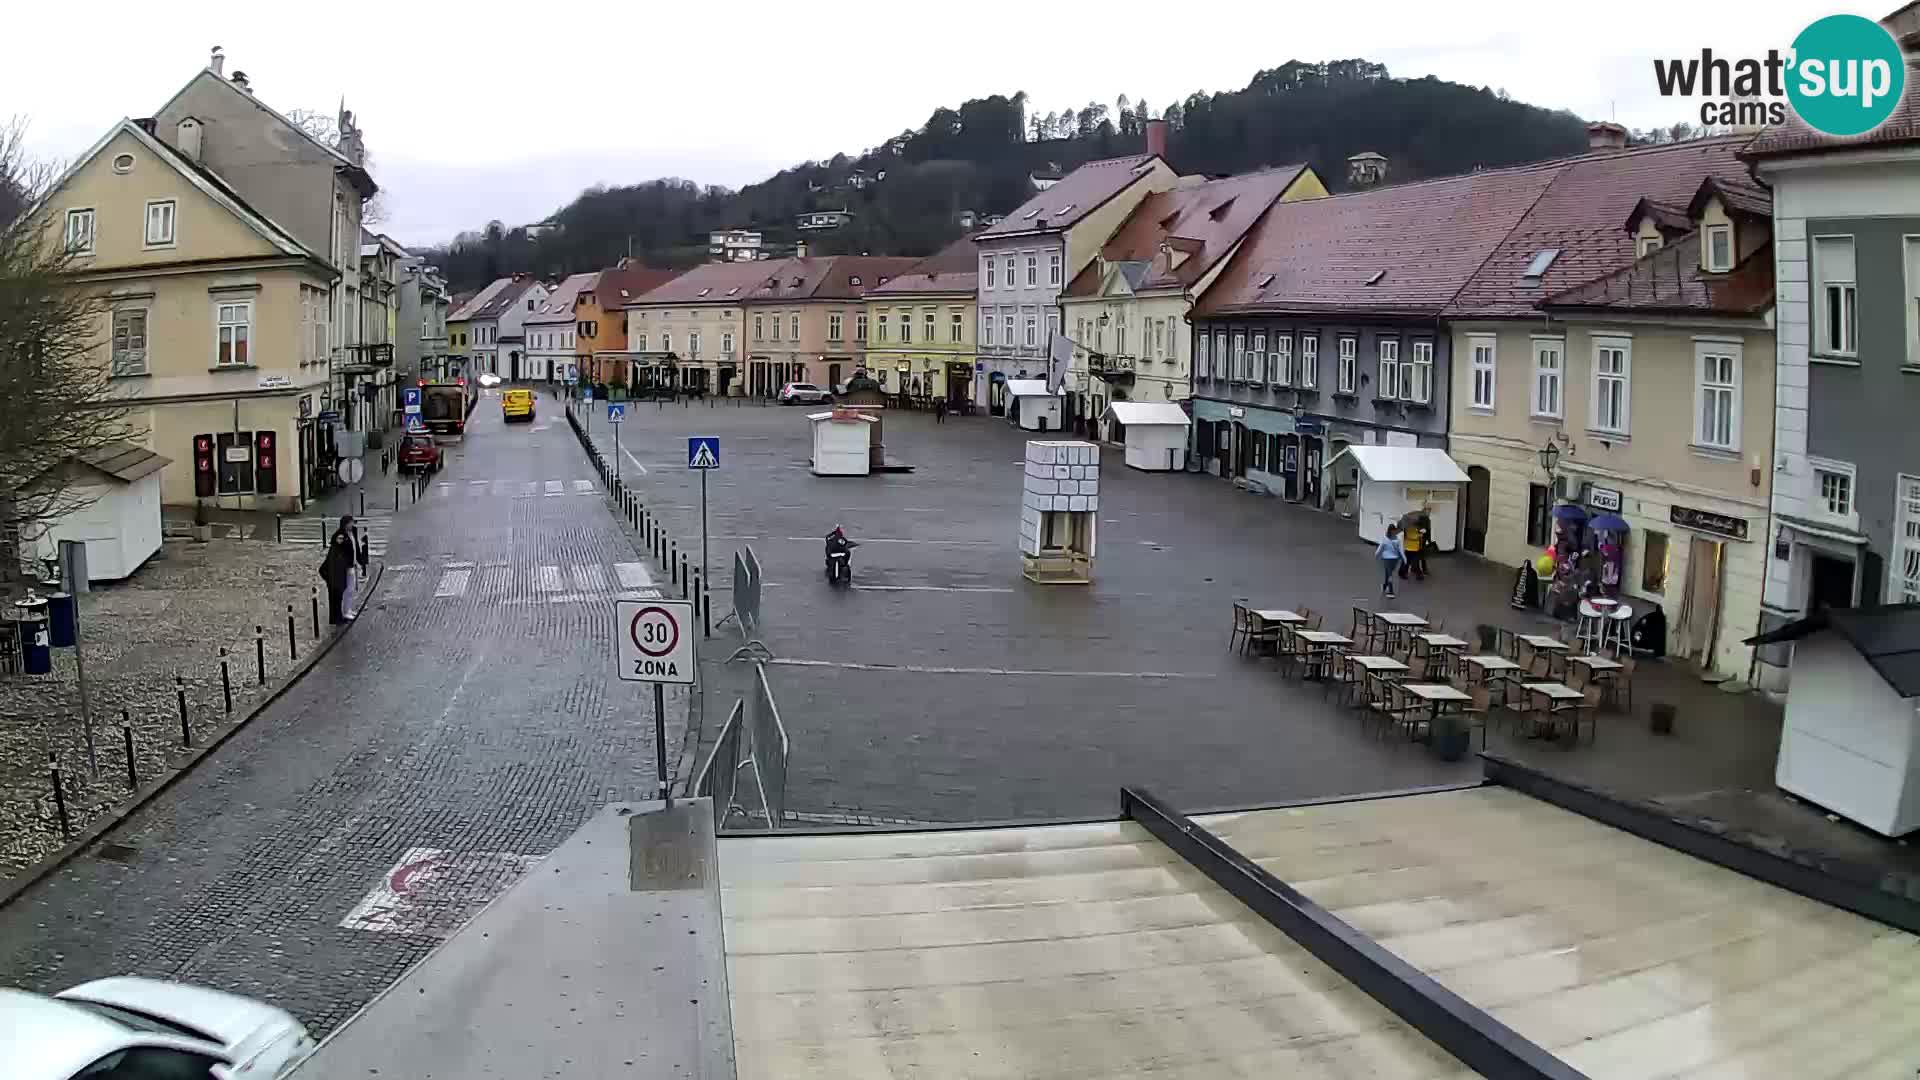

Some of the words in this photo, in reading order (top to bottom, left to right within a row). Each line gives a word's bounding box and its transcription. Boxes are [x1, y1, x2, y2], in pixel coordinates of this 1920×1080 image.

[408, 391, 416, 402] P
[643, 622, 667, 643] 30
[634, 660, 678, 676] ZONA
